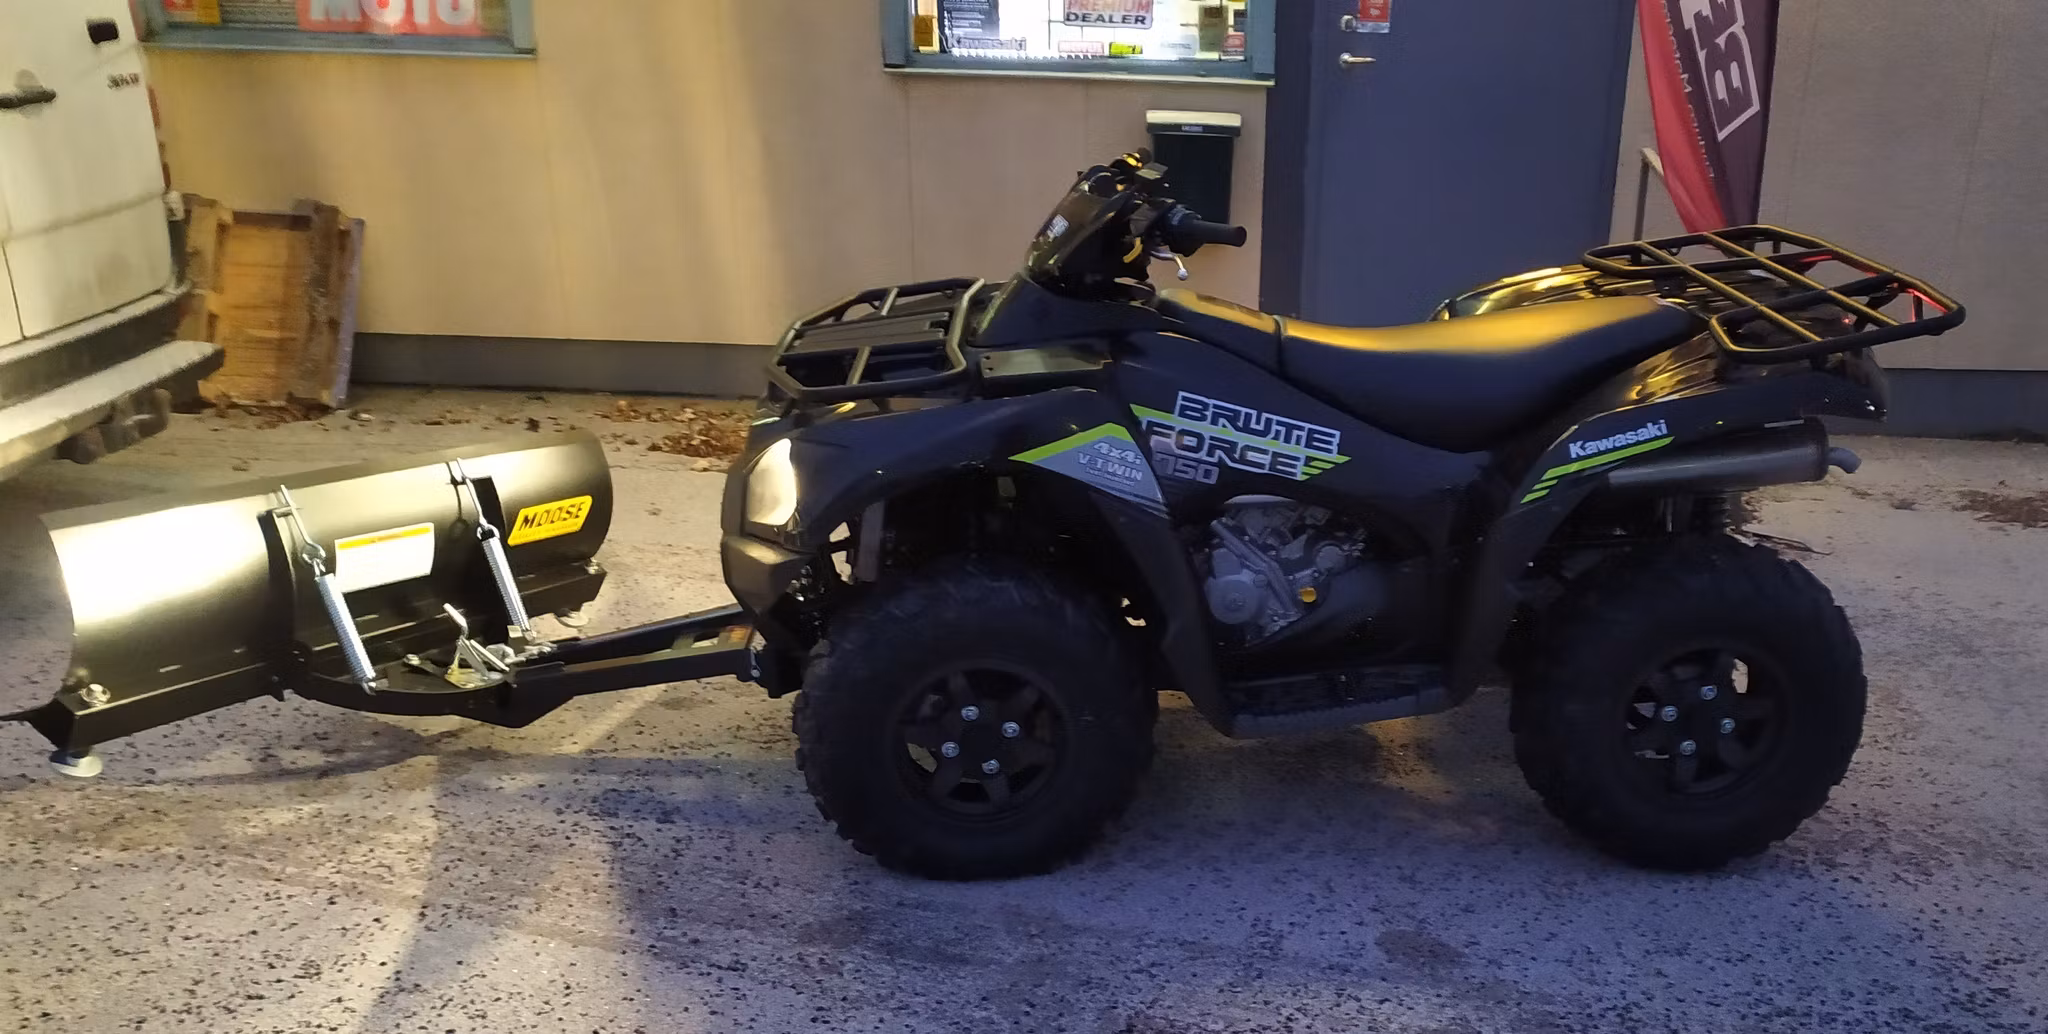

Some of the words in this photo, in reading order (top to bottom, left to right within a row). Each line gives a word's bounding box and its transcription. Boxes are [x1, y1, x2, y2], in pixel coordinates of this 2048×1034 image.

[1065, 11, 1147, 25] DEALER
[1174, 391, 1340, 455] BRUTE
[1569, 420, 1668, 458] Kawasaki
[1078, 452, 1143, 481] V-TWIN
[1144, 420, 1306, 480] FORCE
[519, 501, 586, 531] MOOSE
